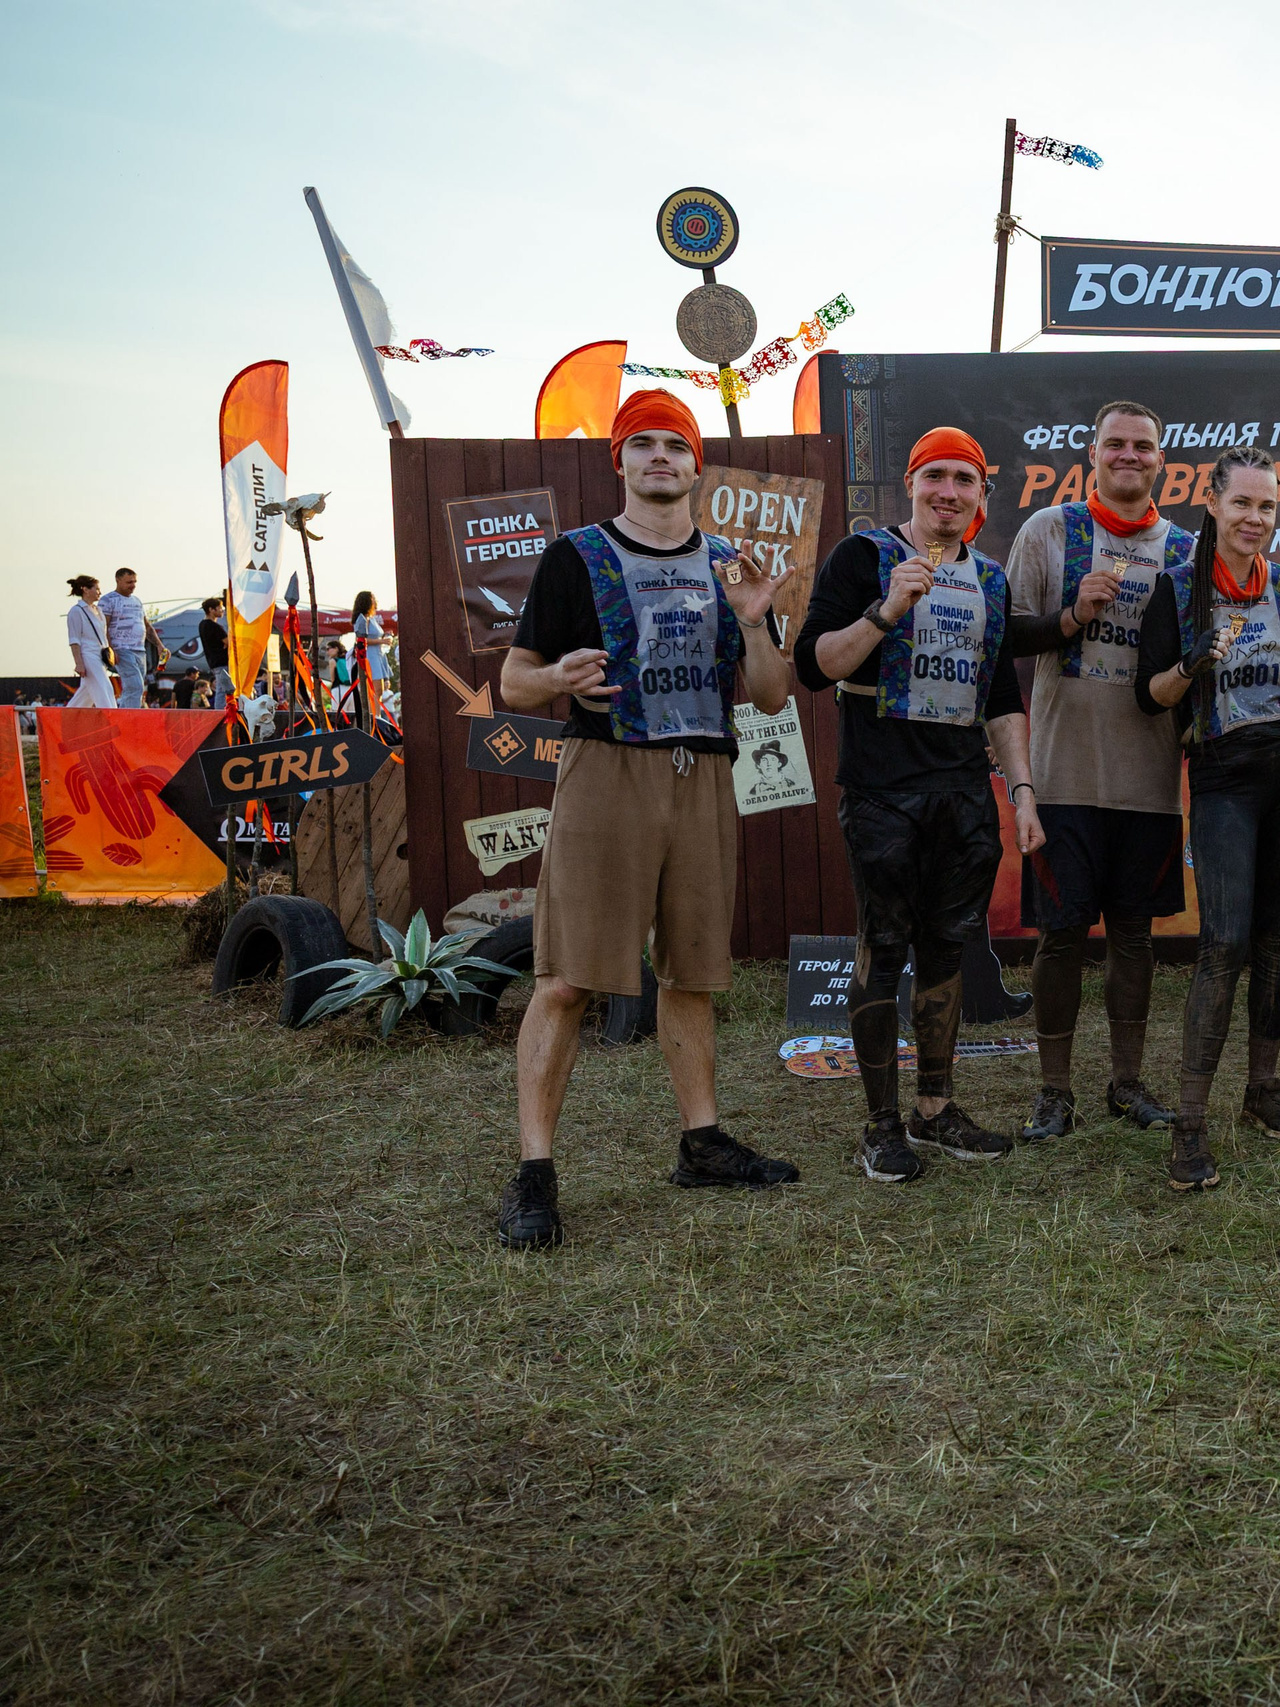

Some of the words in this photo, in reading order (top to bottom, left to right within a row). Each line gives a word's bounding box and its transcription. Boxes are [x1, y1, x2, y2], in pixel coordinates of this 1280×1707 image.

[1023, 422, 1260, 450] ФЕСЛЬНАЯ
[252, 463, 267, 553] САТЕЛЛИТ
[711, 485, 806, 537] OPEN
[466, 513, 540, 537] ГОНКА
[466, 537, 548, 563] ГЕРОЕВ
[1129, 554, 1158, 566] ГЕРОЕВ
[634, 579, 667, 589] ГОНКА
[671, 578, 708, 588] ГЕРОЕВ
[949, 579, 978, 590] ГЕРОЕВ
[652, 610, 703, 625] КОМАНДА
[930, 603, 974, 622] КОМАНДА
[493, 620, 514, 629] ЛИГА
[1086, 619, 1140, 648] 0380
[647, 638, 705, 660] РОМА
[641, 665, 718, 695] 03804
[914, 654, 978, 686] 03803
[1220, 664, 1280, 694] 03801
[756, 724, 778, 738] THE
[779, 721, 797, 735] KID
[221, 742, 349, 792] GIRLS
[746, 796, 768, 805] DEAD
[769, 793, 780, 801] OR
[782, 788, 806, 798] ALIVE
[477, 821, 550, 856] WANT
[797, 959, 841, 972] ГЕРОЙ
[810, 994, 831, 1006] ДО
